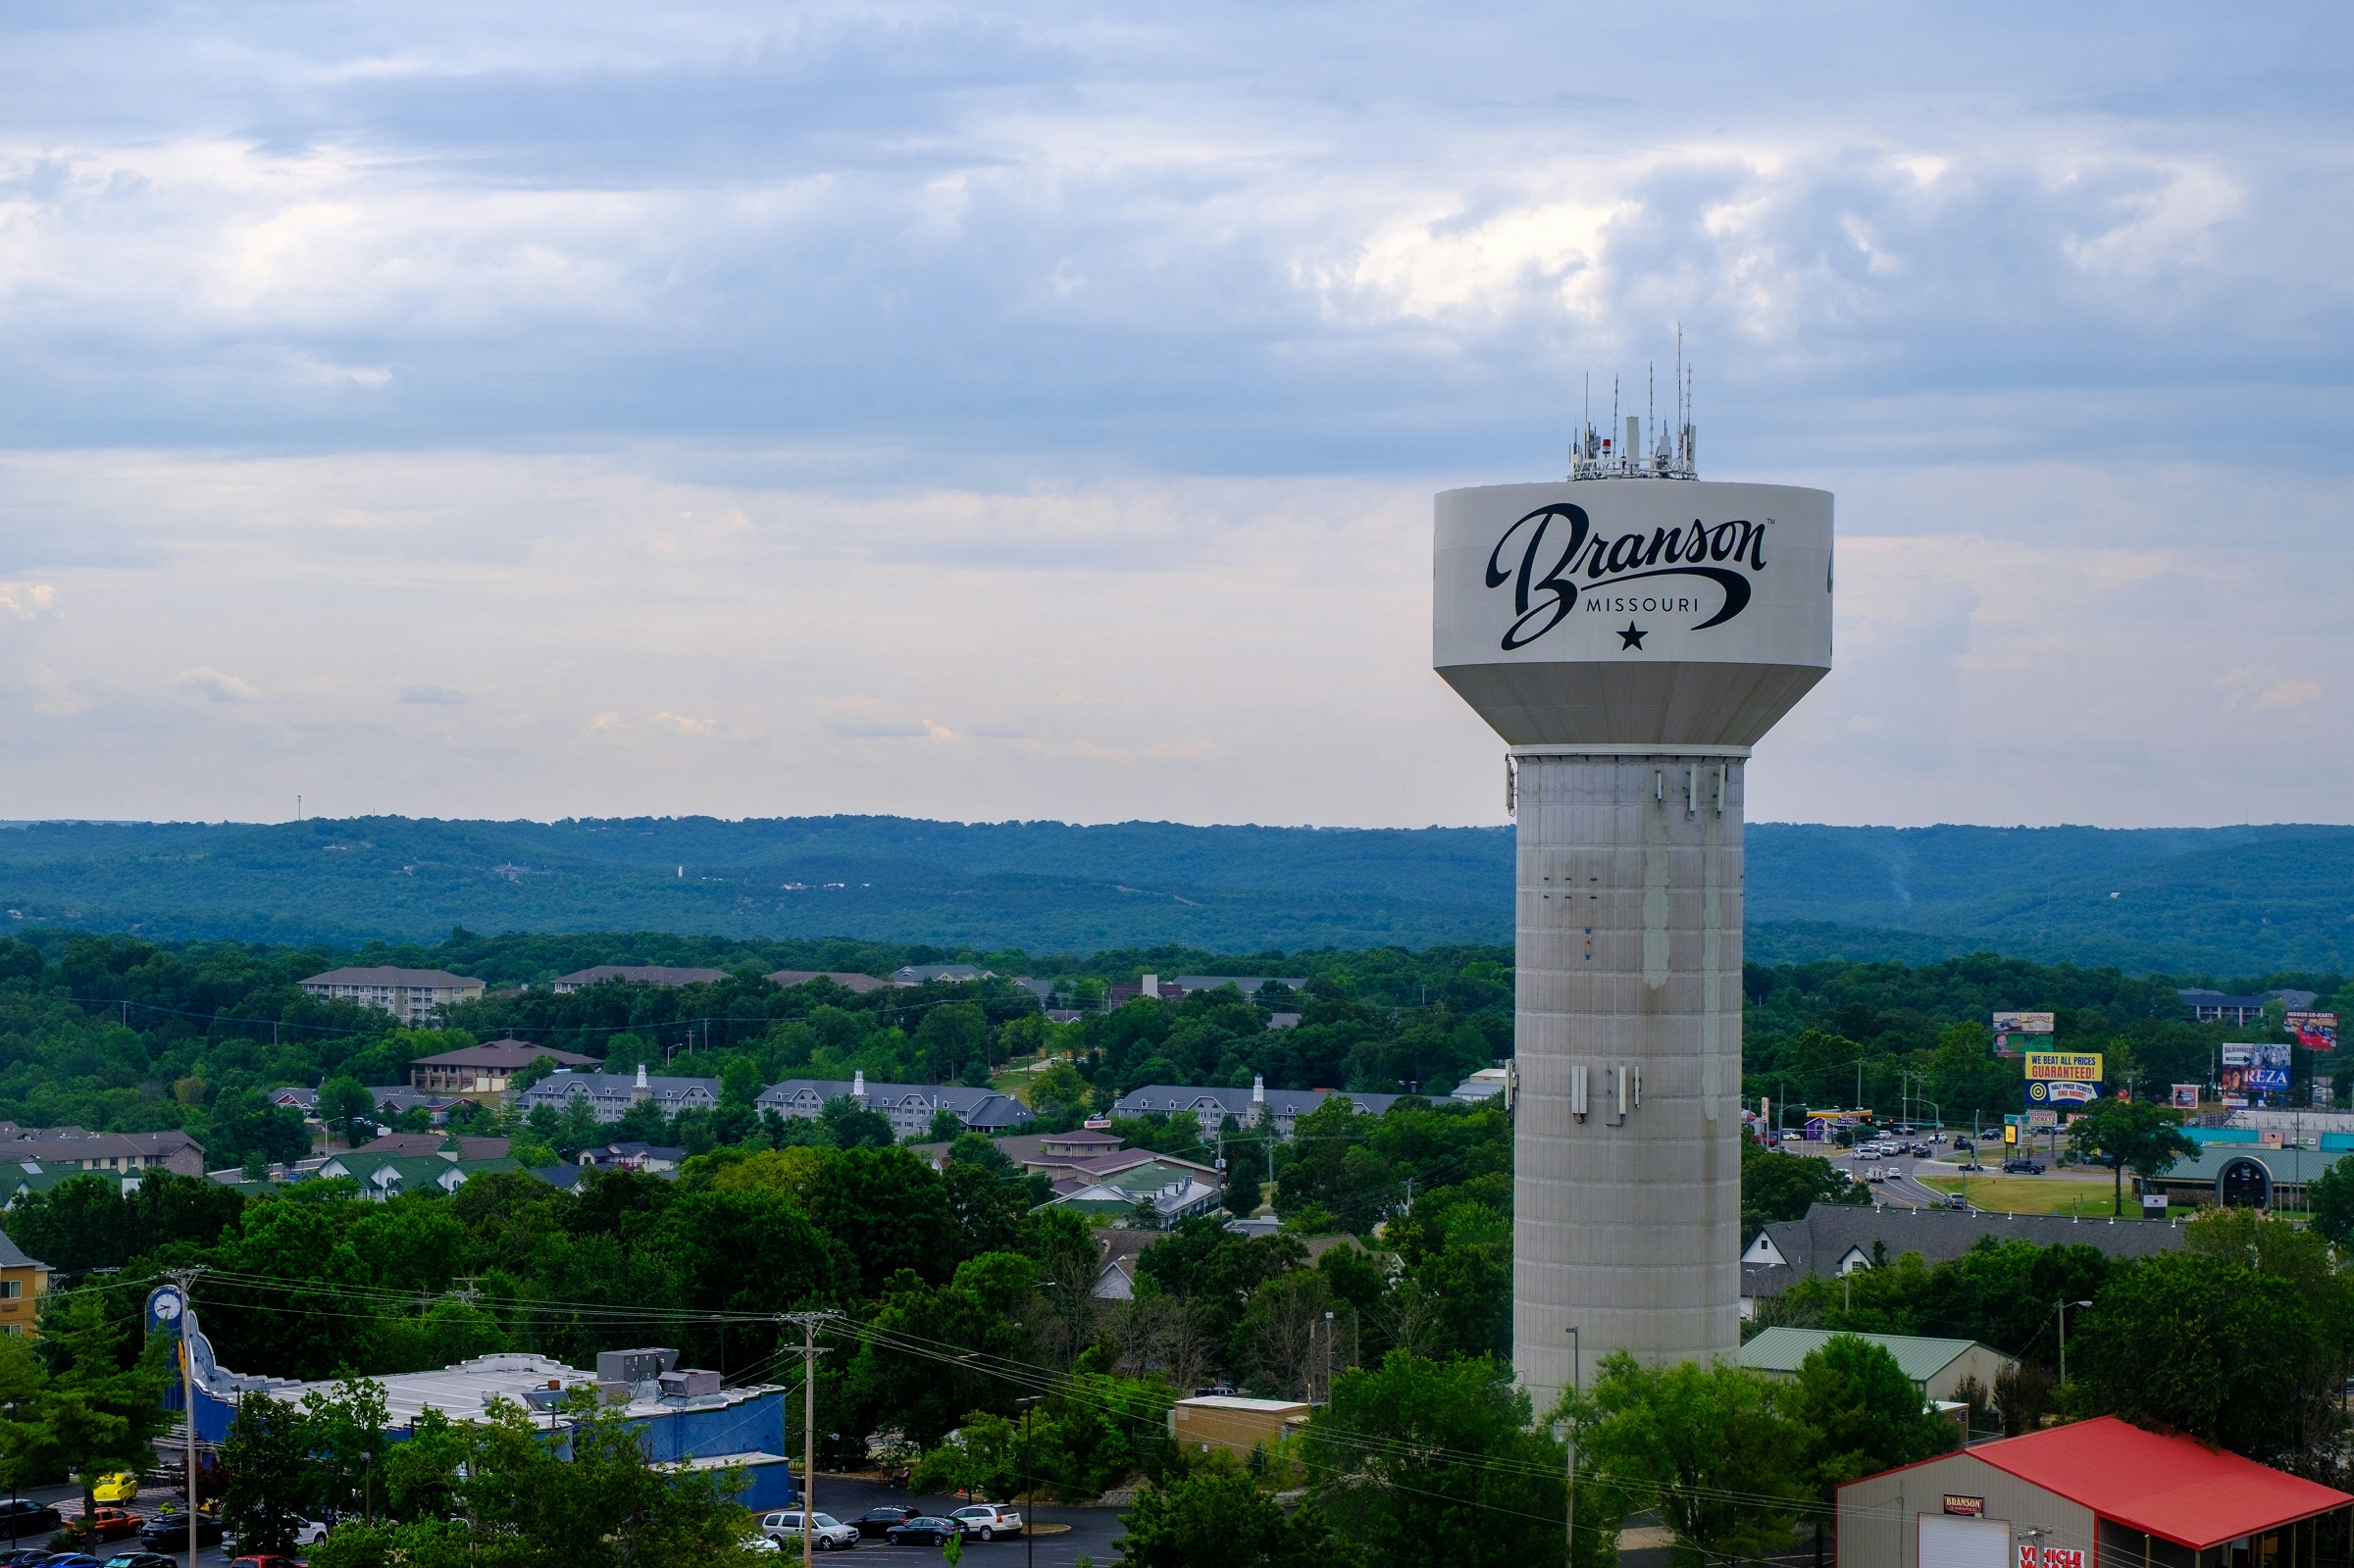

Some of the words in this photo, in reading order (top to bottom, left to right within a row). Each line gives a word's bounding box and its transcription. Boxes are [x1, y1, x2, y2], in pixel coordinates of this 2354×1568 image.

[1485, 502, 1767, 651] Branson
[1586, 597, 1699, 613] MISSOURI
[2061, 1056, 2071, 1065] ALL
[2073, 1056, 2096, 1066] PRICES
[2032, 1066, 2095, 1079] GUARANTEED!
[2243, 1070, 2287, 1083] REZA
[2075, 1085, 2093, 1094] TICKETS
[1946, 1497, 1979, 1508] BRANSON
